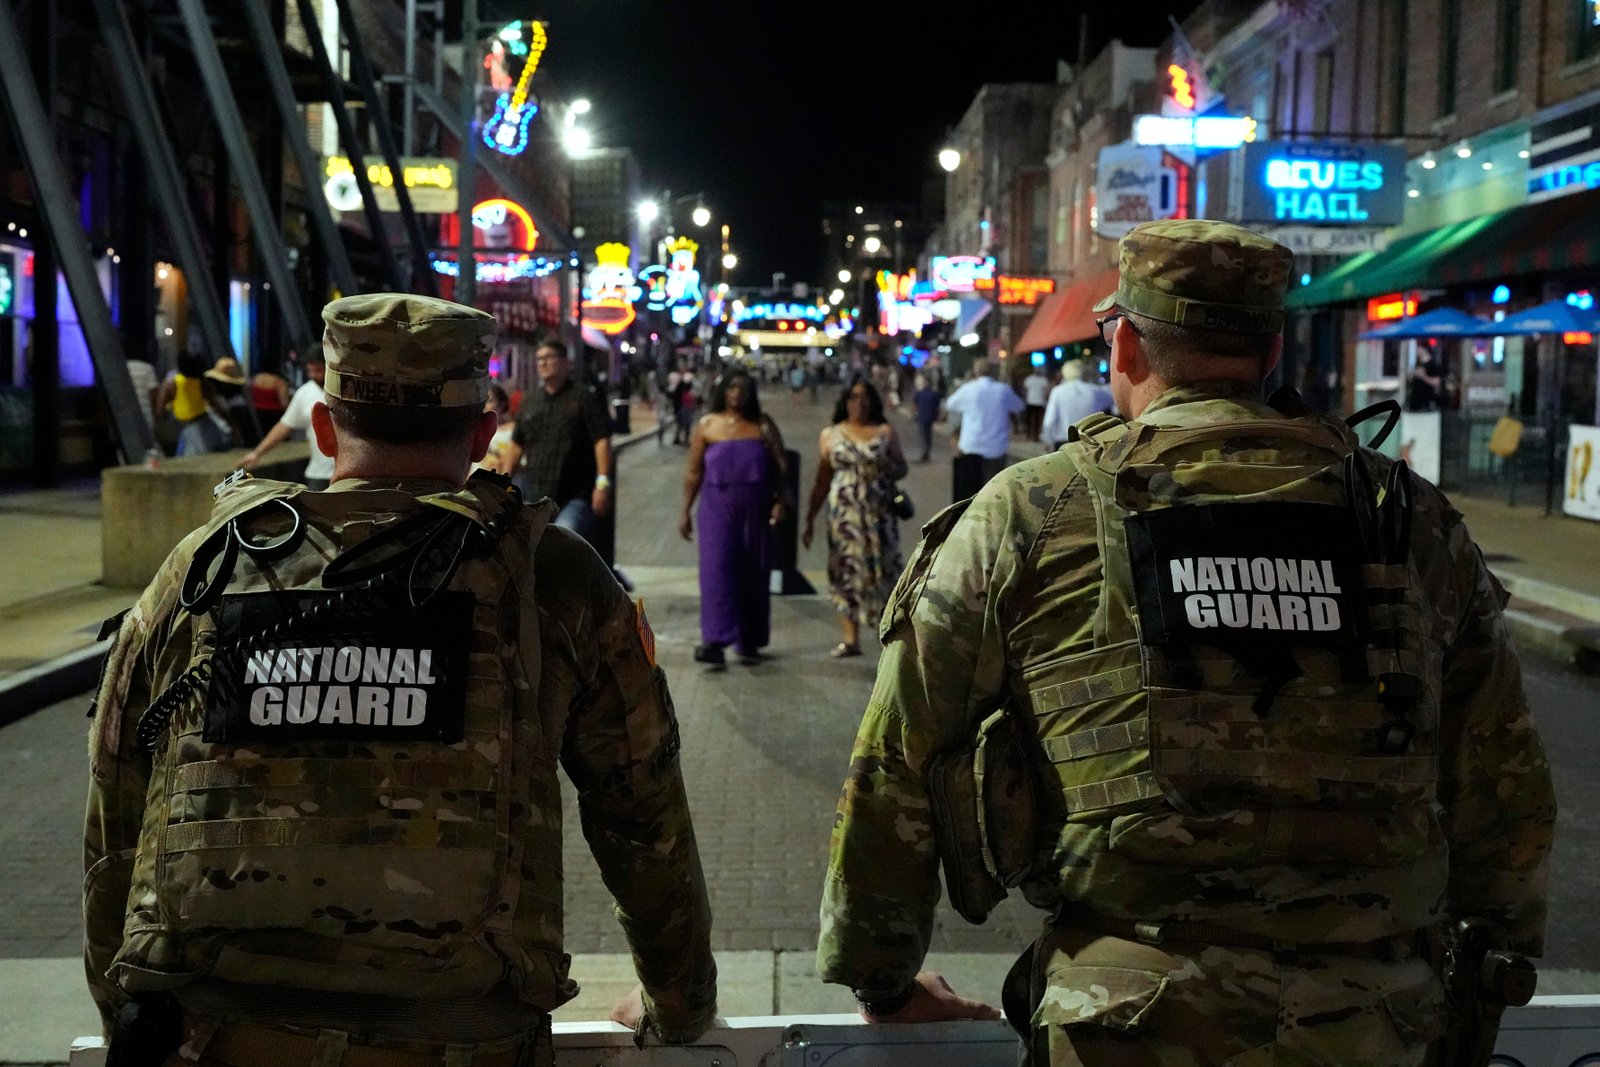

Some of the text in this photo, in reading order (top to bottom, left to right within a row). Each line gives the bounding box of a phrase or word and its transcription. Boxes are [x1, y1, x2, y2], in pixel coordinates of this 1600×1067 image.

[1266, 159, 1384, 190] BLUES
[1275, 191, 1369, 221] HALL
[1169, 556, 1342, 594] NATIONAL
[1184, 593, 1342, 631] GUARD
[244, 645, 436, 685] NATIONAL
[249, 685, 428, 726] GUARD
